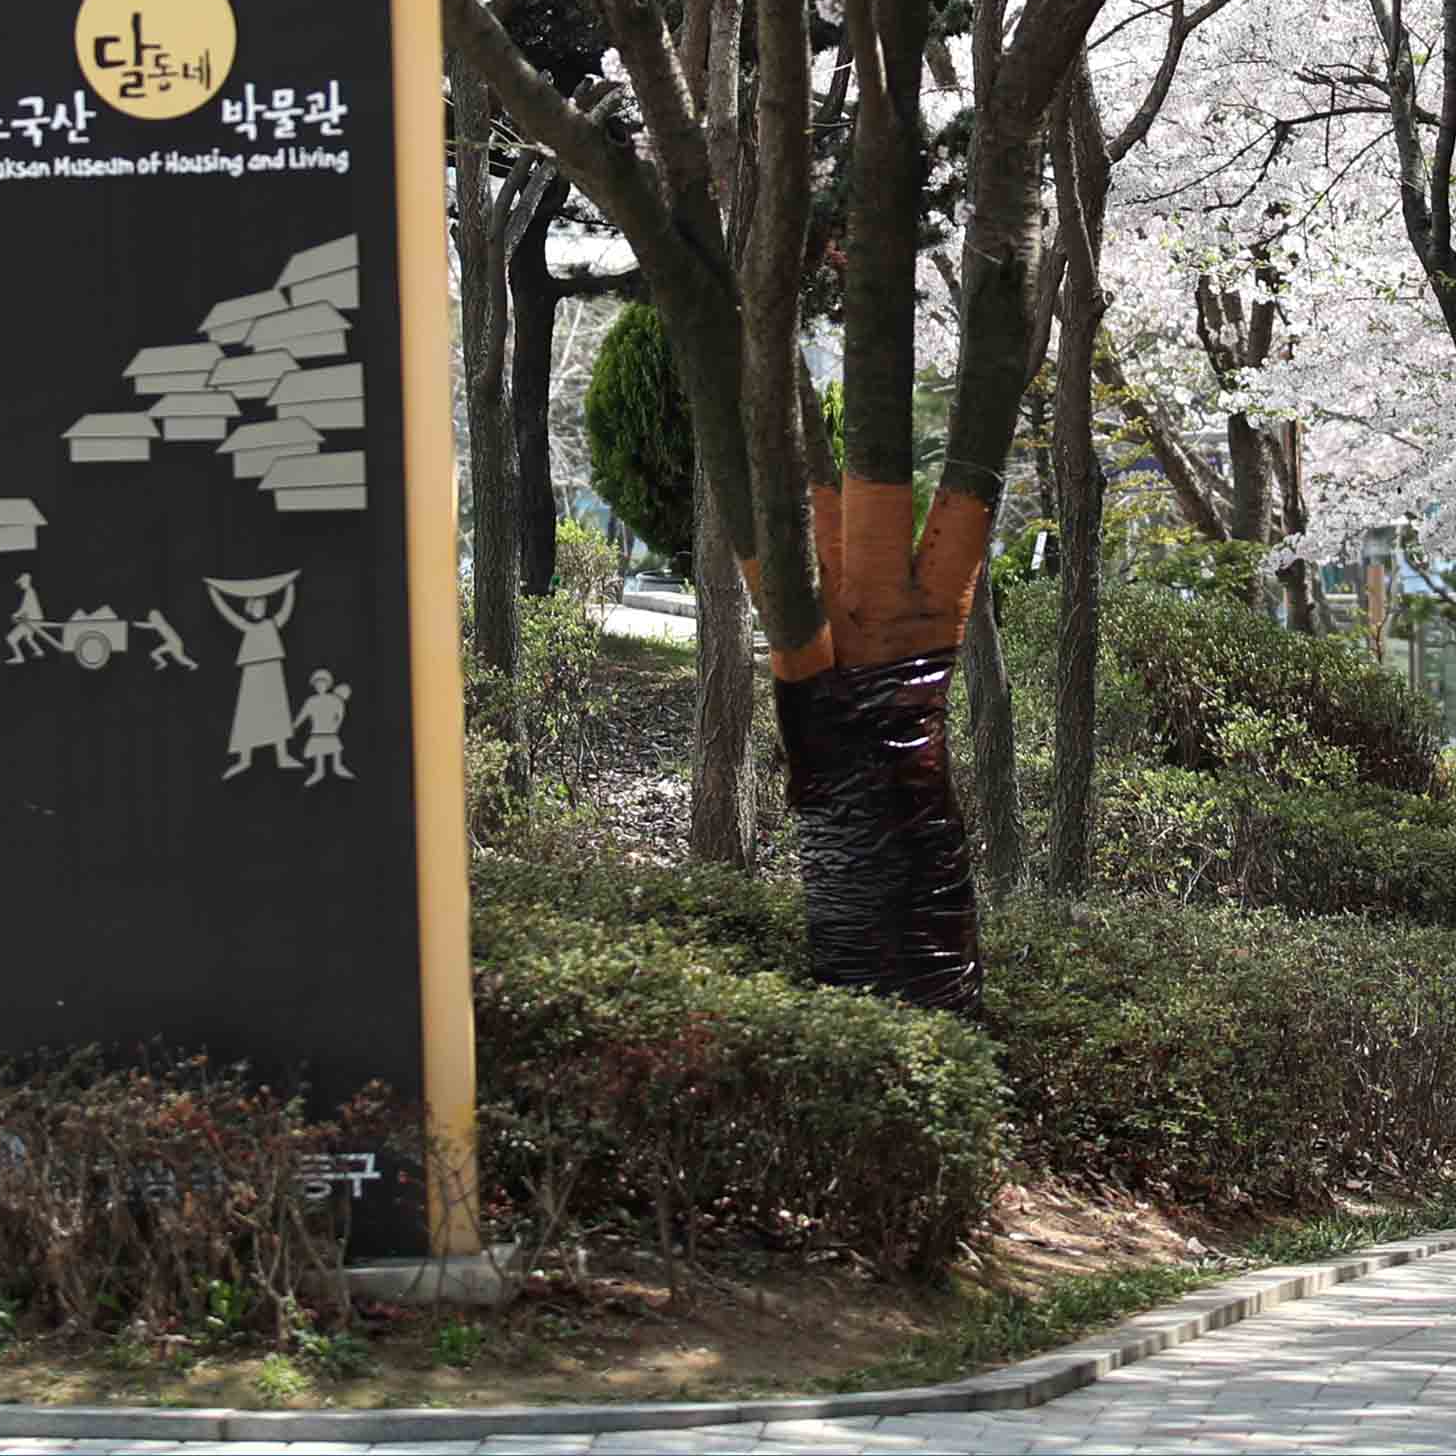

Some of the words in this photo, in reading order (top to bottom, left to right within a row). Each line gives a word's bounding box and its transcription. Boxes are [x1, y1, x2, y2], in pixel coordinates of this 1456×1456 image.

[93, 11, 211, 99] 달동네
[222, 80, 348, 141] 박물관
[54, 155, 134, 177] Museum
[137, 151, 162, 174] of
[165, 148, 243, 177] Housing
[247, 148, 285, 171] and
[288, 147, 349, 173] Living
